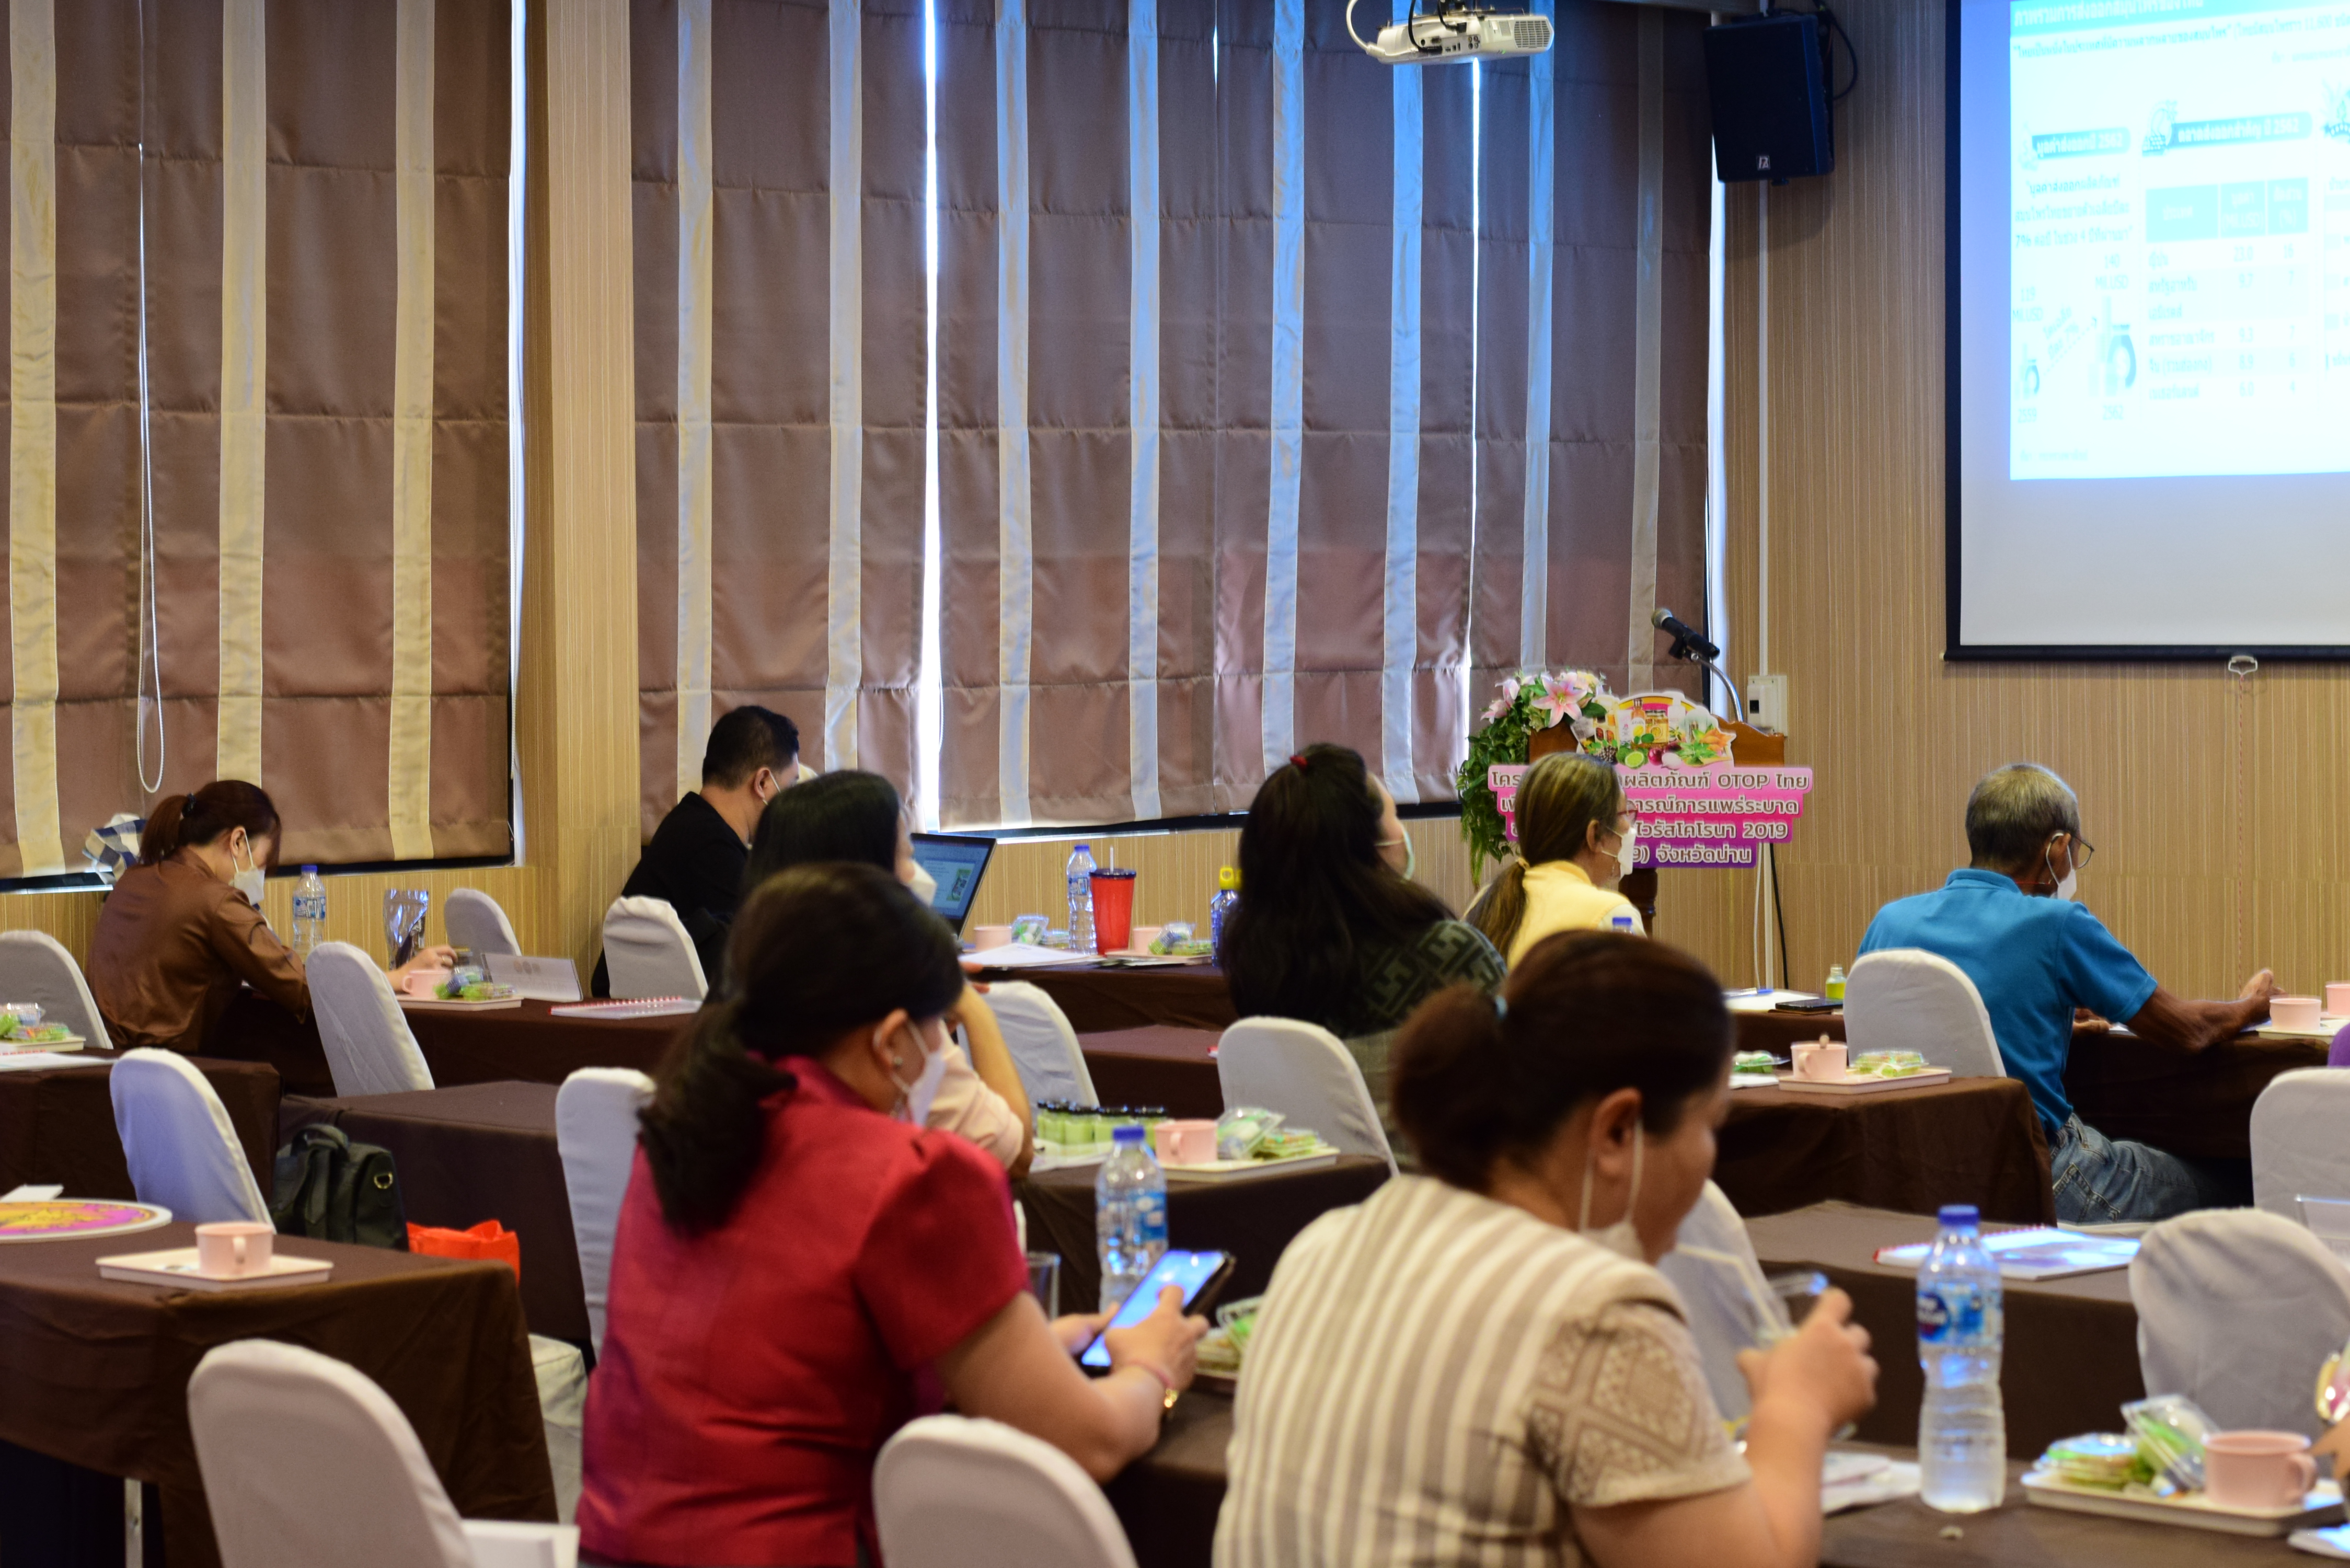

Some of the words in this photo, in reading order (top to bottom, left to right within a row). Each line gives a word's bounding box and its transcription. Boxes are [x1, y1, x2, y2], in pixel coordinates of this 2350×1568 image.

[2274, 118, 2300, 135] 2562
[2098, 133, 2123, 149] 2562
[1621, 771, 1710, 788] ผลิตภัณฑ์
[1718, 774, 1769, 789] OTOP
[1776, 774, 1809, 789] ไทย
[1743, 822, 1788, 839] 2019
[1657, 843, 1752, 863] จังหวัดน่าน
